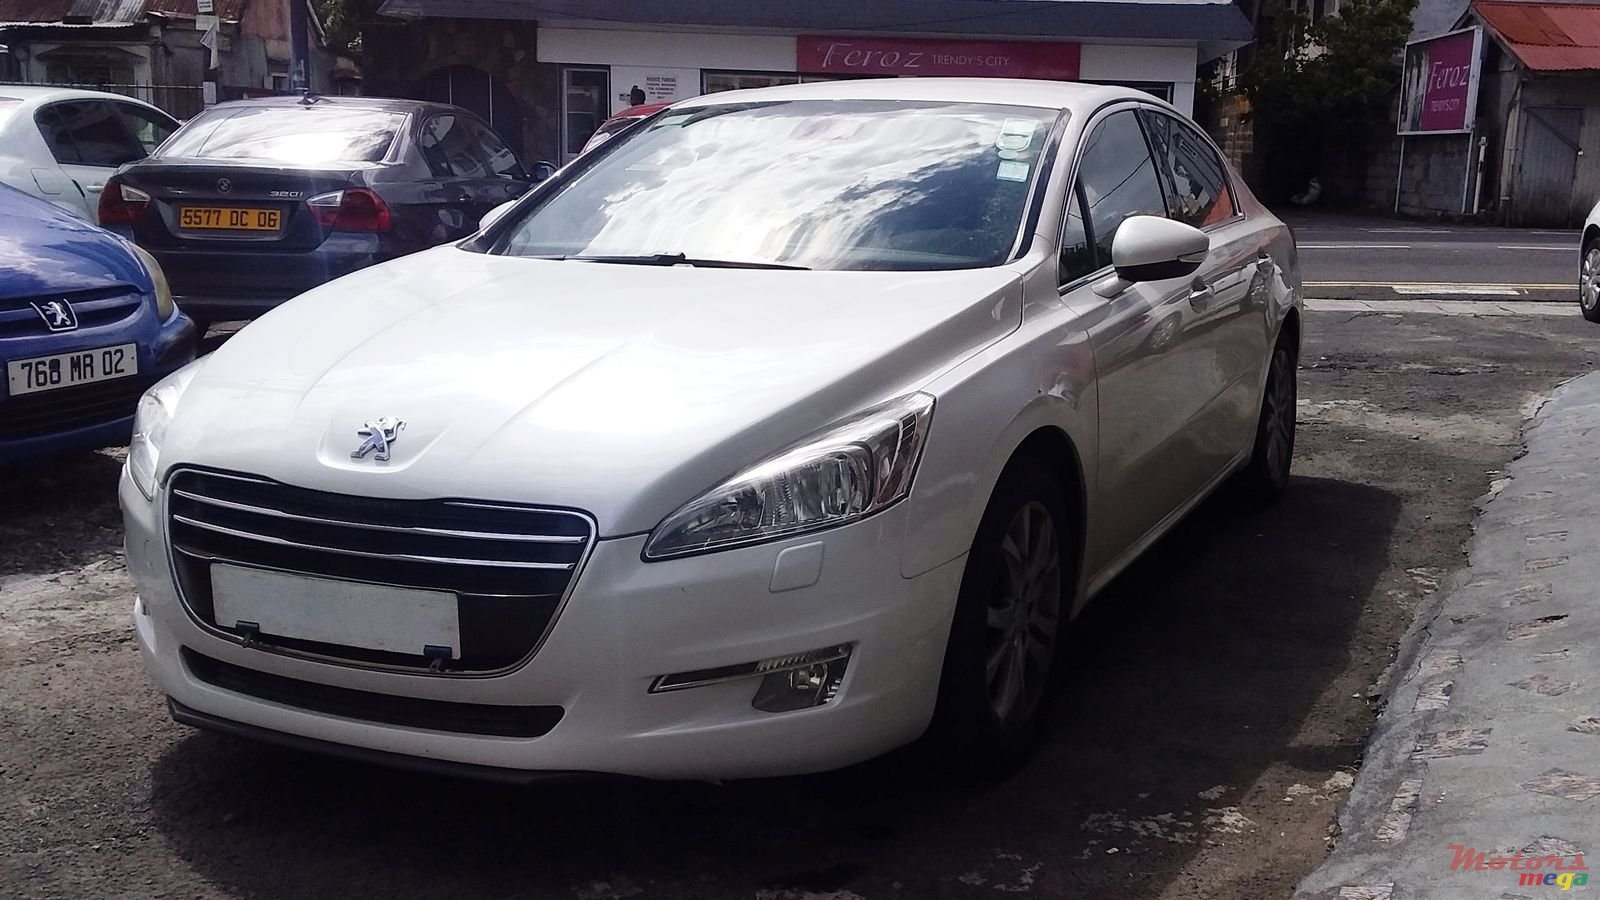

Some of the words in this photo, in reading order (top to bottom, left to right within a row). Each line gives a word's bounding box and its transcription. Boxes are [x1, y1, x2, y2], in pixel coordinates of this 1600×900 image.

[817, 42, 924, 69] Feroz
[985, 55, 1010, 67] CITY
[1428, 61, 1470, 93] Feroz
[269, 190, 304, 198] 320i
[182, 209, 222, 226] 5577
[229, 210, 249, 227] DC
[257, 211, 278, 228] 06
[21, 358, 61, 389] 768
[70, 353, 94, 382] MR
[102, 348, 125, 376] 02
